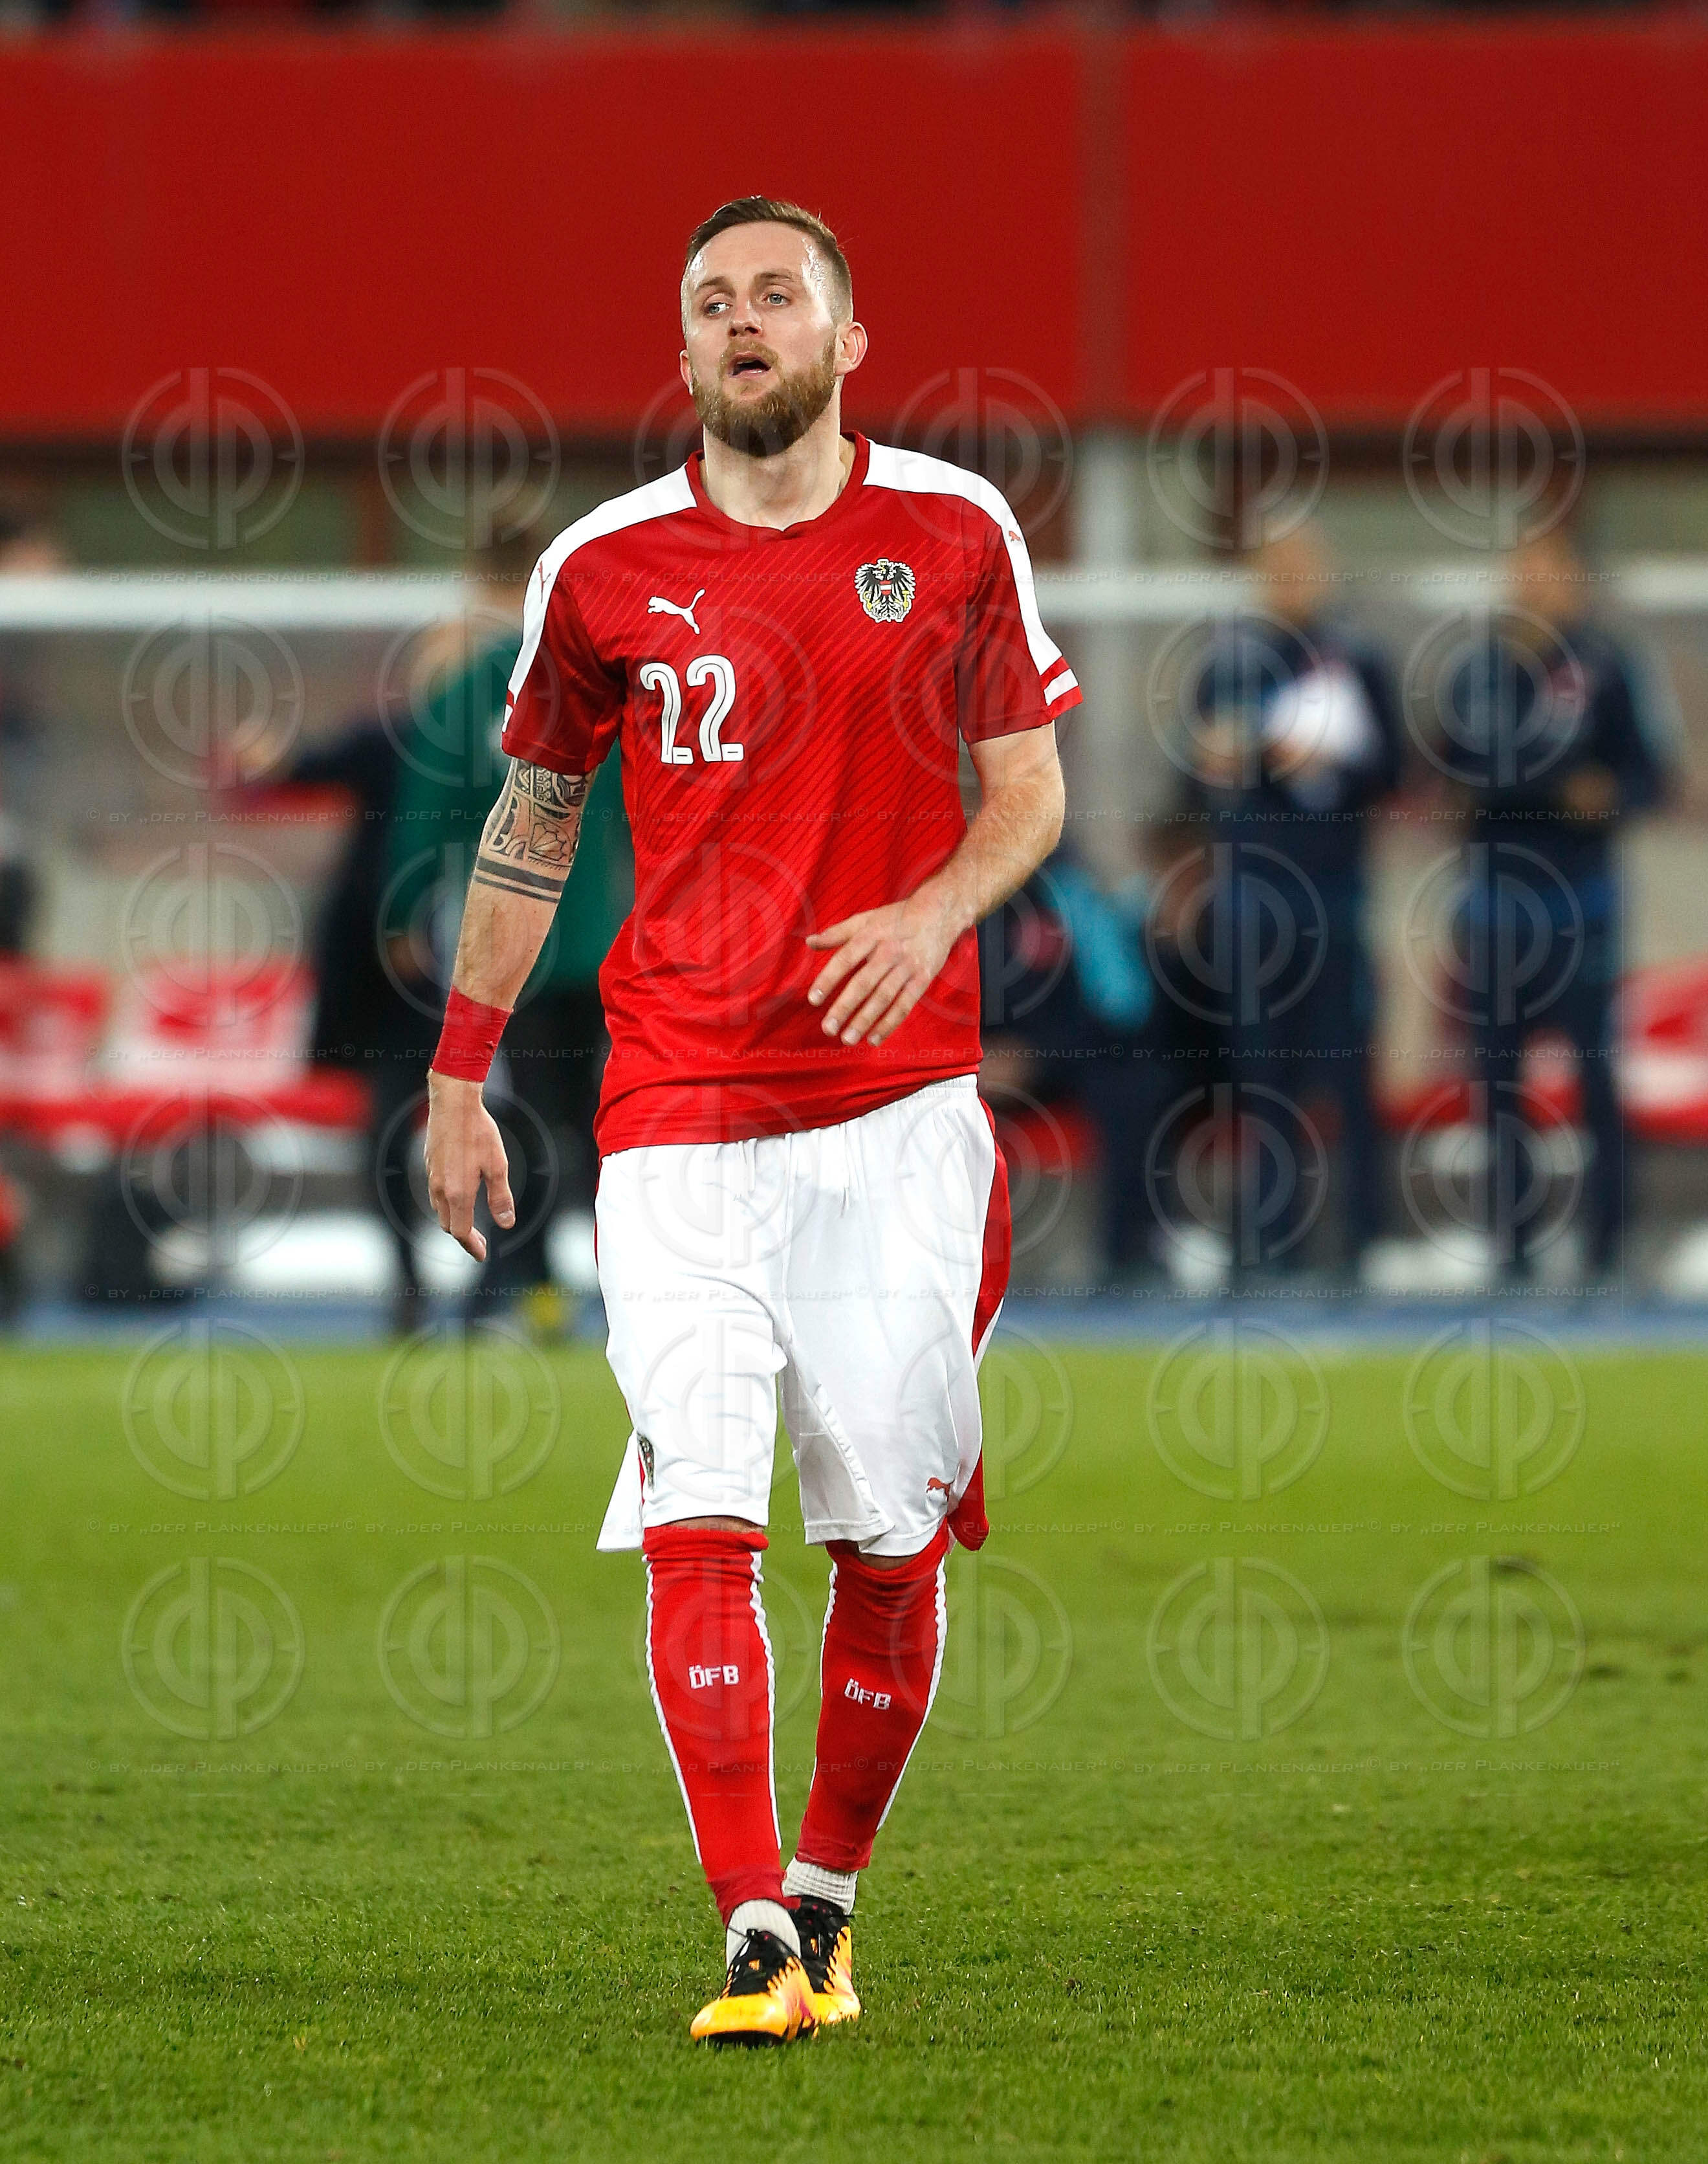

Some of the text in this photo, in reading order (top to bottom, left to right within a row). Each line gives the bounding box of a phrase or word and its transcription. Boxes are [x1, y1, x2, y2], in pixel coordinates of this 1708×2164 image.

[639, 654, 744, 764] 22
[688, 1664, 739, 1689] ÖFB
[844, 1678, 892, 1710] ÖFB
